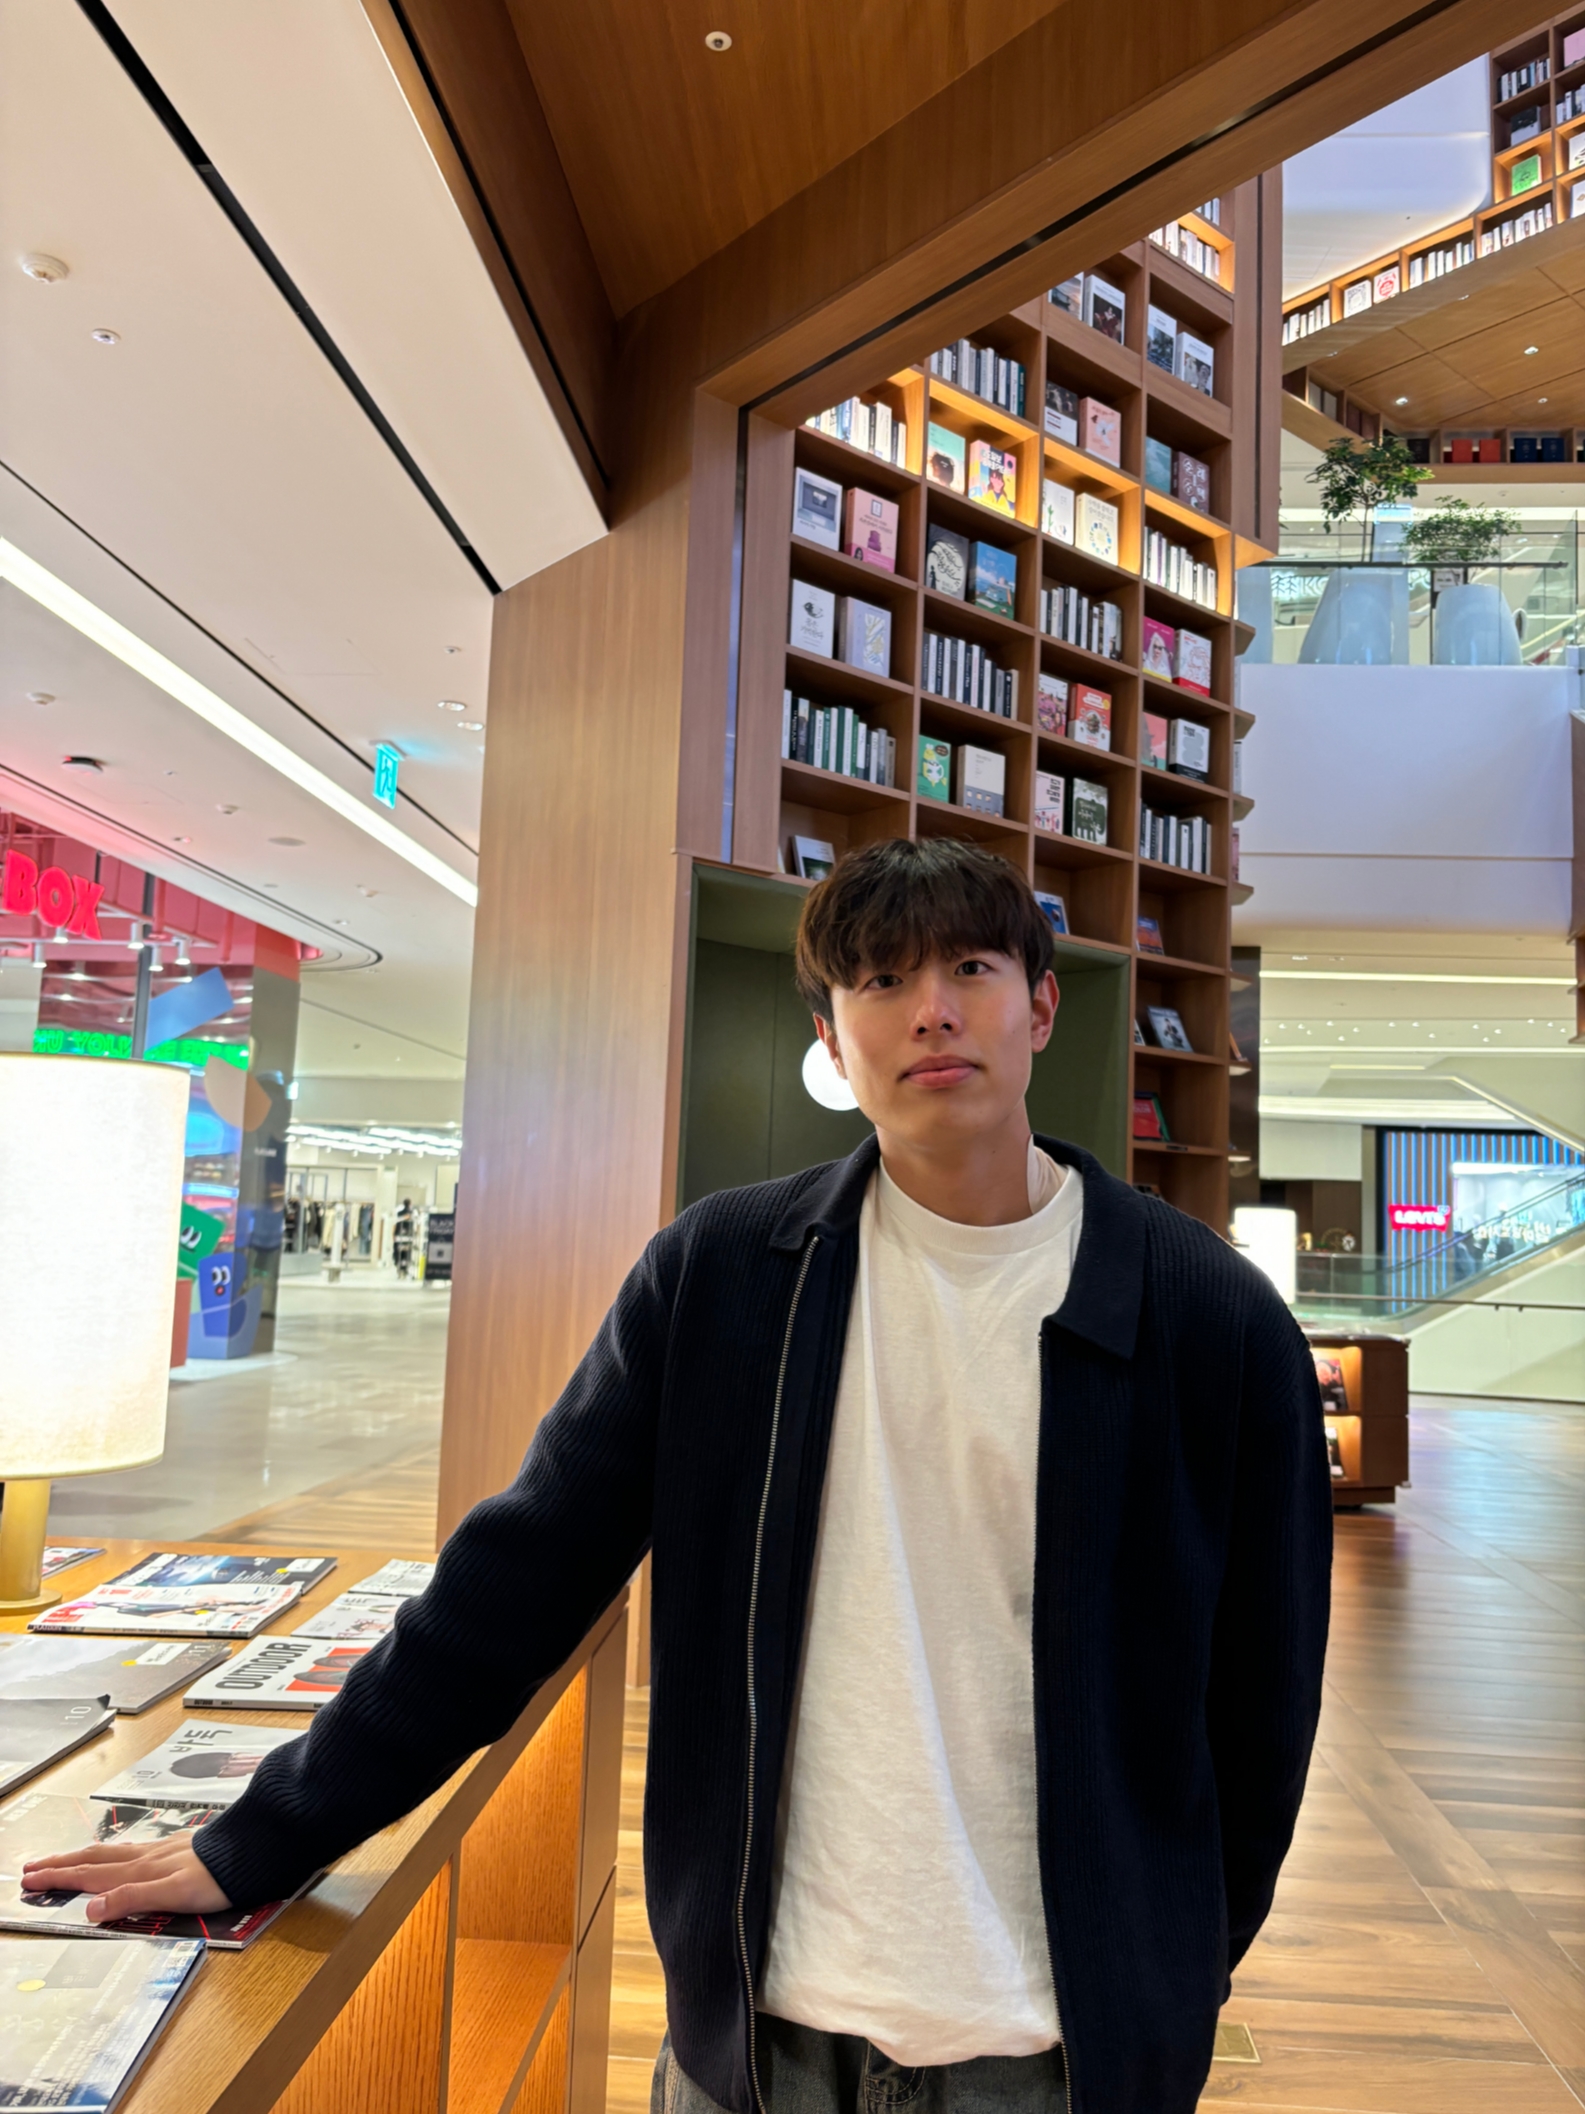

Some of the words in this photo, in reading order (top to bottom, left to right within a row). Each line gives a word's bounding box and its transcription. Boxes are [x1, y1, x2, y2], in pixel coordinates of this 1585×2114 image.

[2, 849, 105, 942] BOX
[215, 1642, 312, 1690] OUTDOOR
[65, 1705, 92, 1722] 10
[169, 1729, 233, 1753] 바둑
